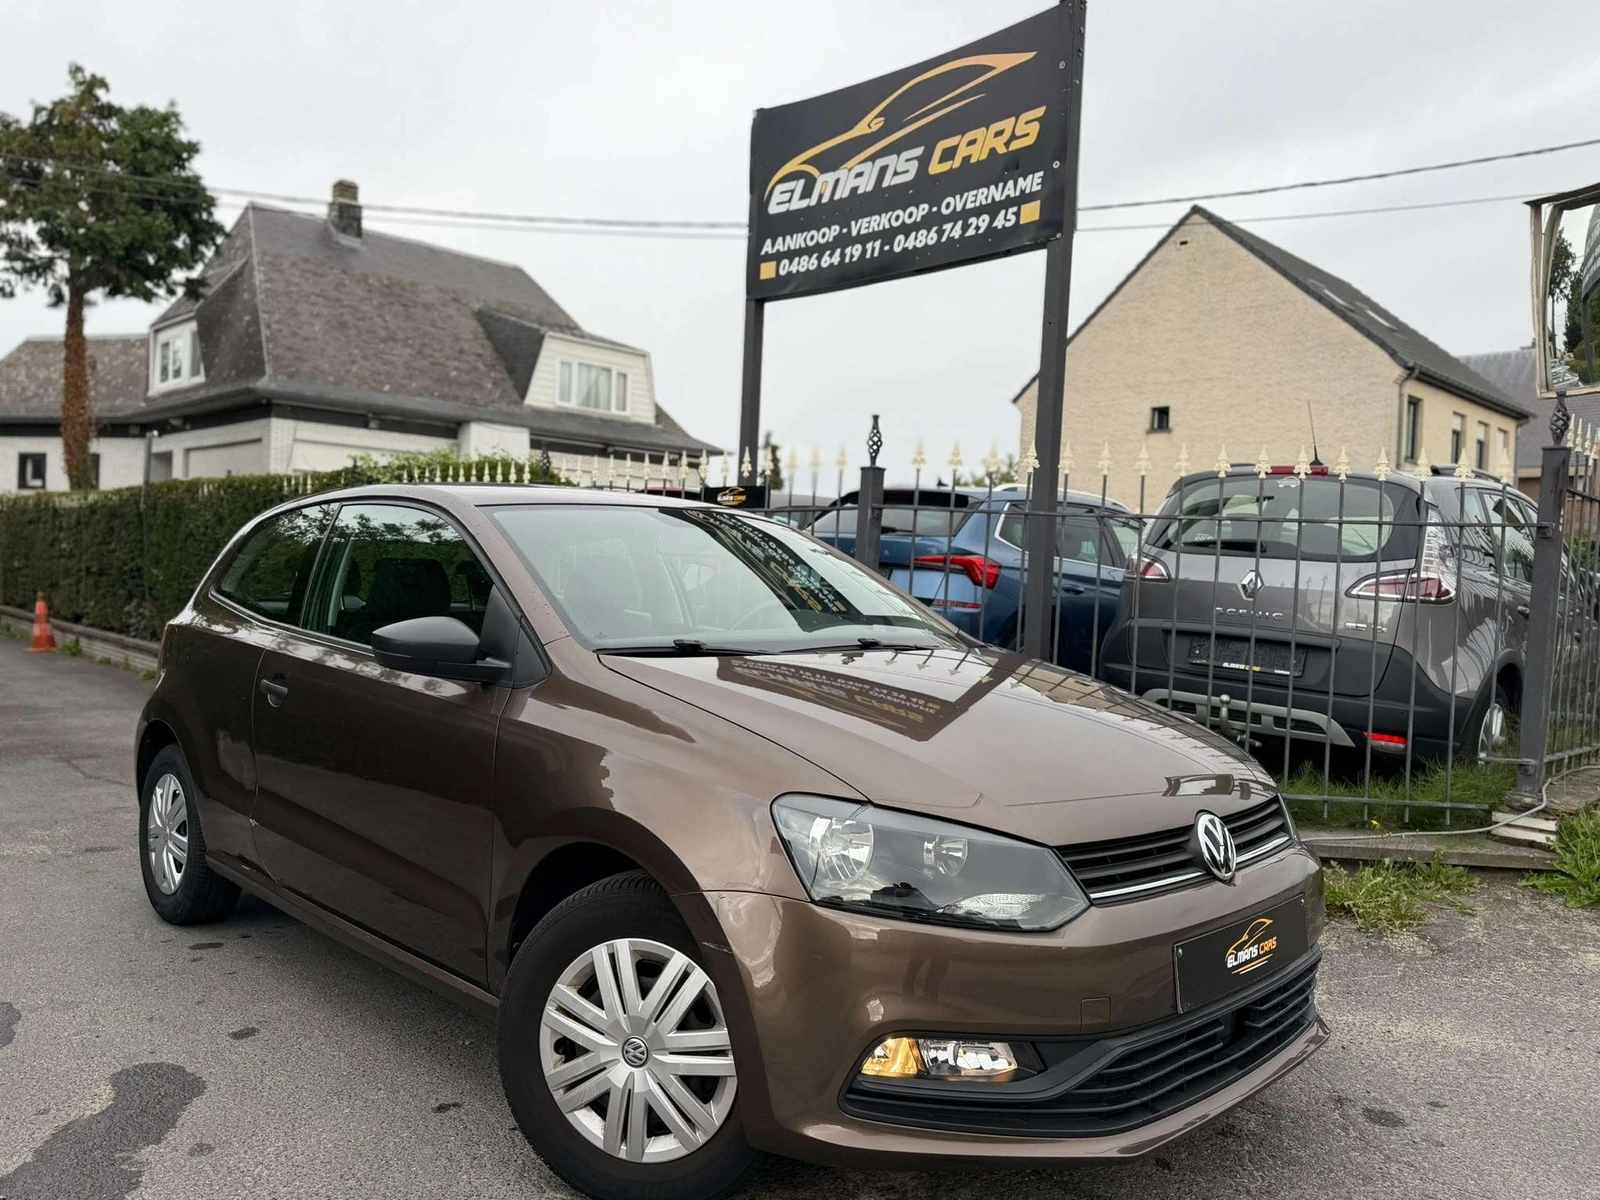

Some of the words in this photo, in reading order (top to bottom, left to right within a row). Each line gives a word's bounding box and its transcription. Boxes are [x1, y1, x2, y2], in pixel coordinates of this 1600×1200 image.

[767, 145, 925, 215] ELMANS
[928, 105, 1047, 176] CARS
[760, 224, 840, 256] AANKOOP
[850, 203, 929, 237] VERKOOP
[940, 170, 1045, 216] OVERNAME
[778, 252, 819, 276] 0486
[820, 248, 841, 268] 64
[844, 243, 862, 264] 19
[865, 239, 882, 259] 11
[893, 226, 938, 253] 0486
[941, 220, 963, 243] 74
[964, 213, 990, 238] 29
[991, 206, 1018, 230] 45
[1226, 943, 1259, 969] ELMANS
[1259, 936, 1277, 955] CARS
